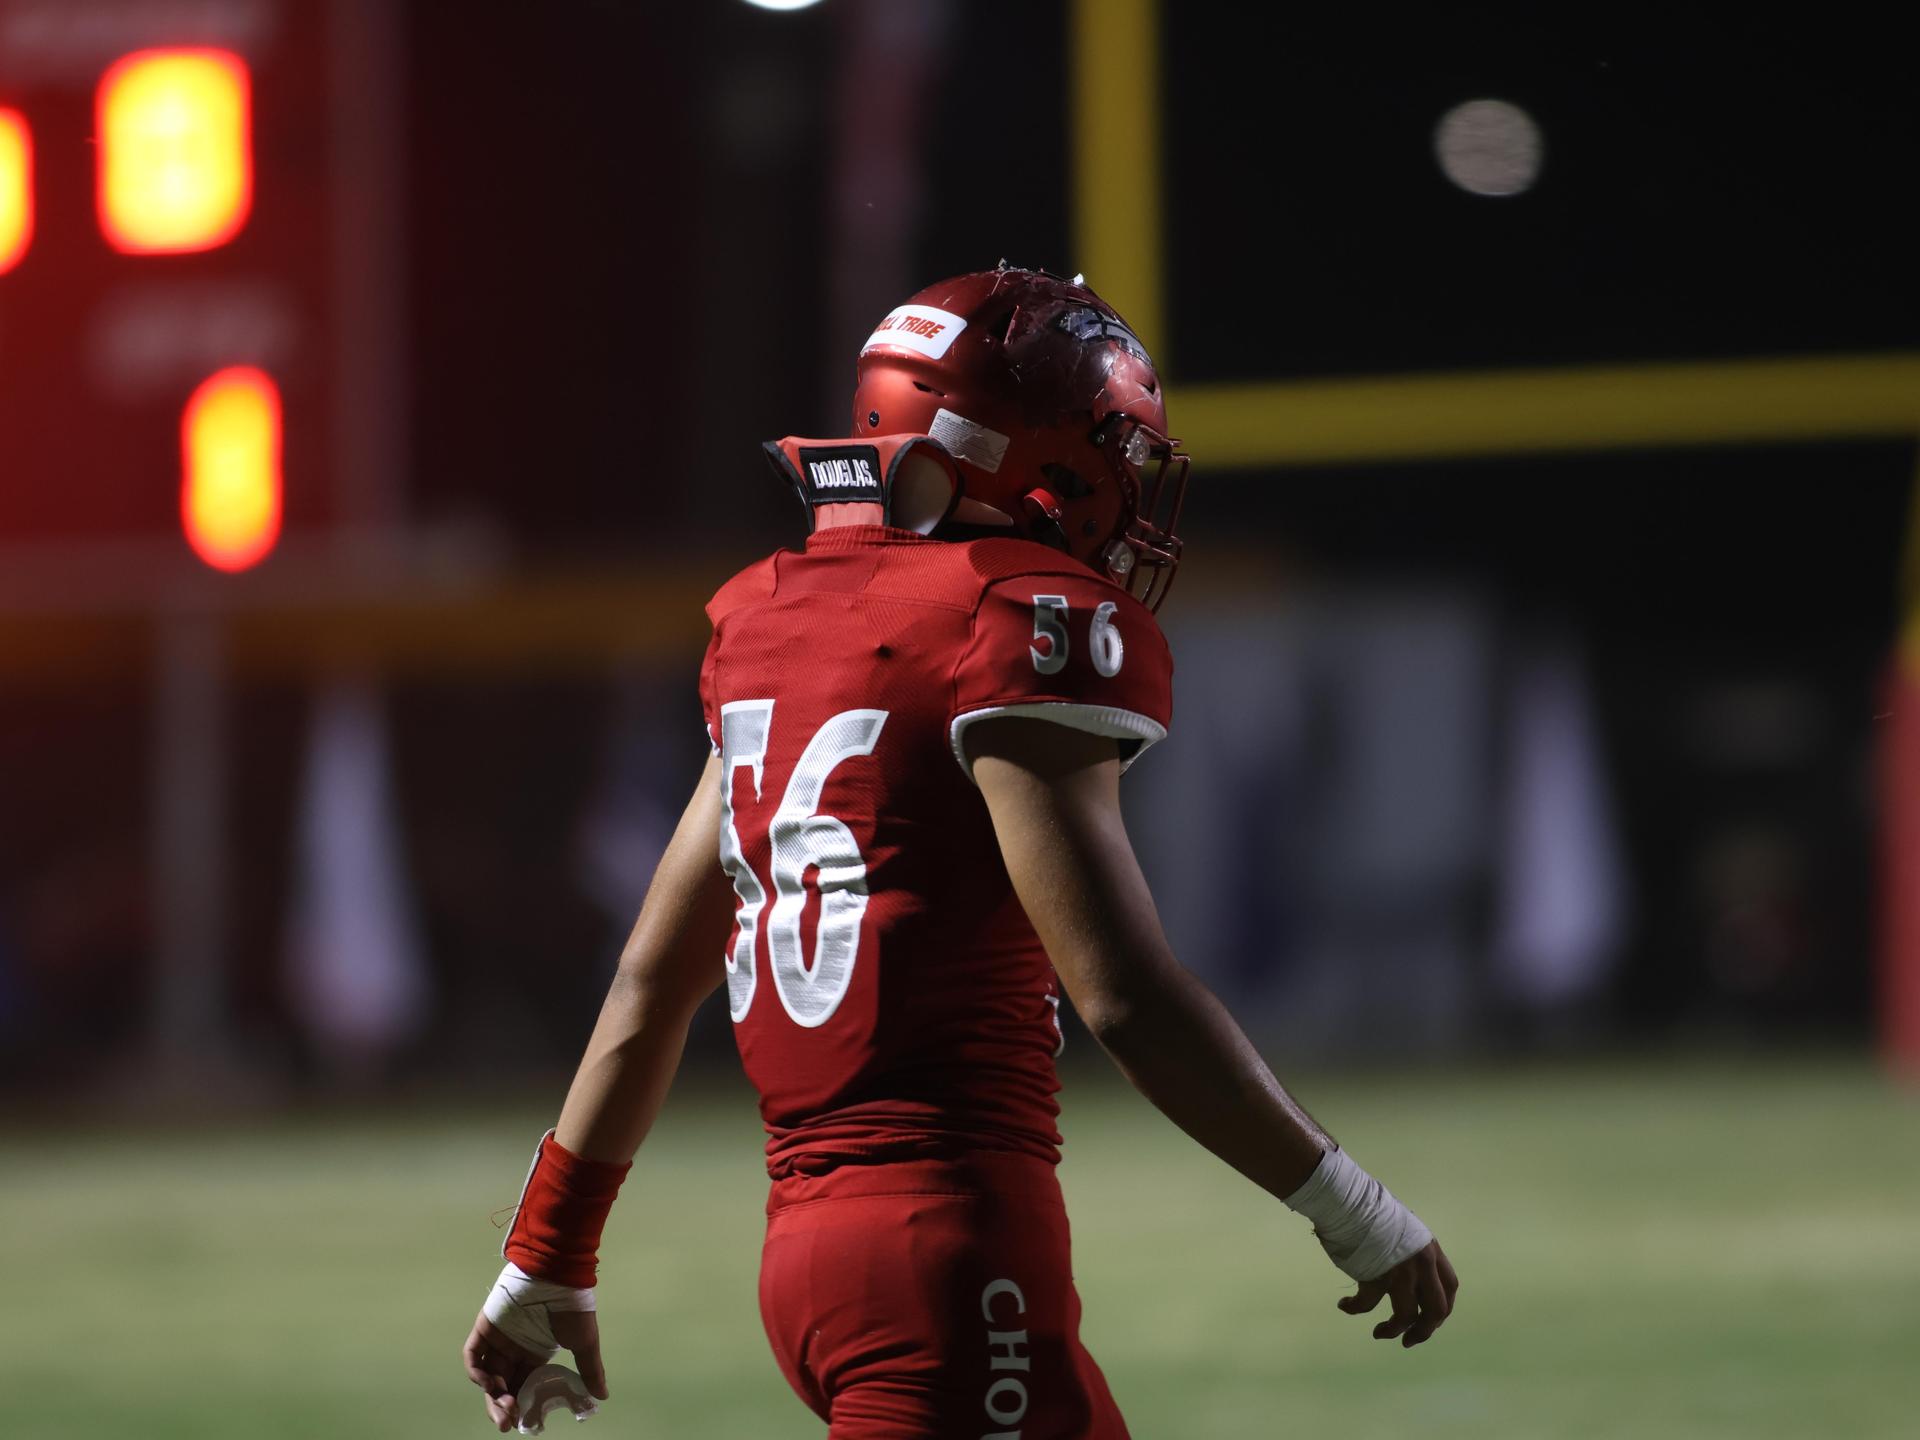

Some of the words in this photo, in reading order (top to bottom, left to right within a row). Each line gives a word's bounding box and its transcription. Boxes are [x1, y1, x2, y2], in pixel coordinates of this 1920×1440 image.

[898, 315, 946, 339] TRIBE
[1029, 594, 1124, 678] 56
[719, 699, 890, 1028] 56
[980, 1278, 1031, 1440] CHO
